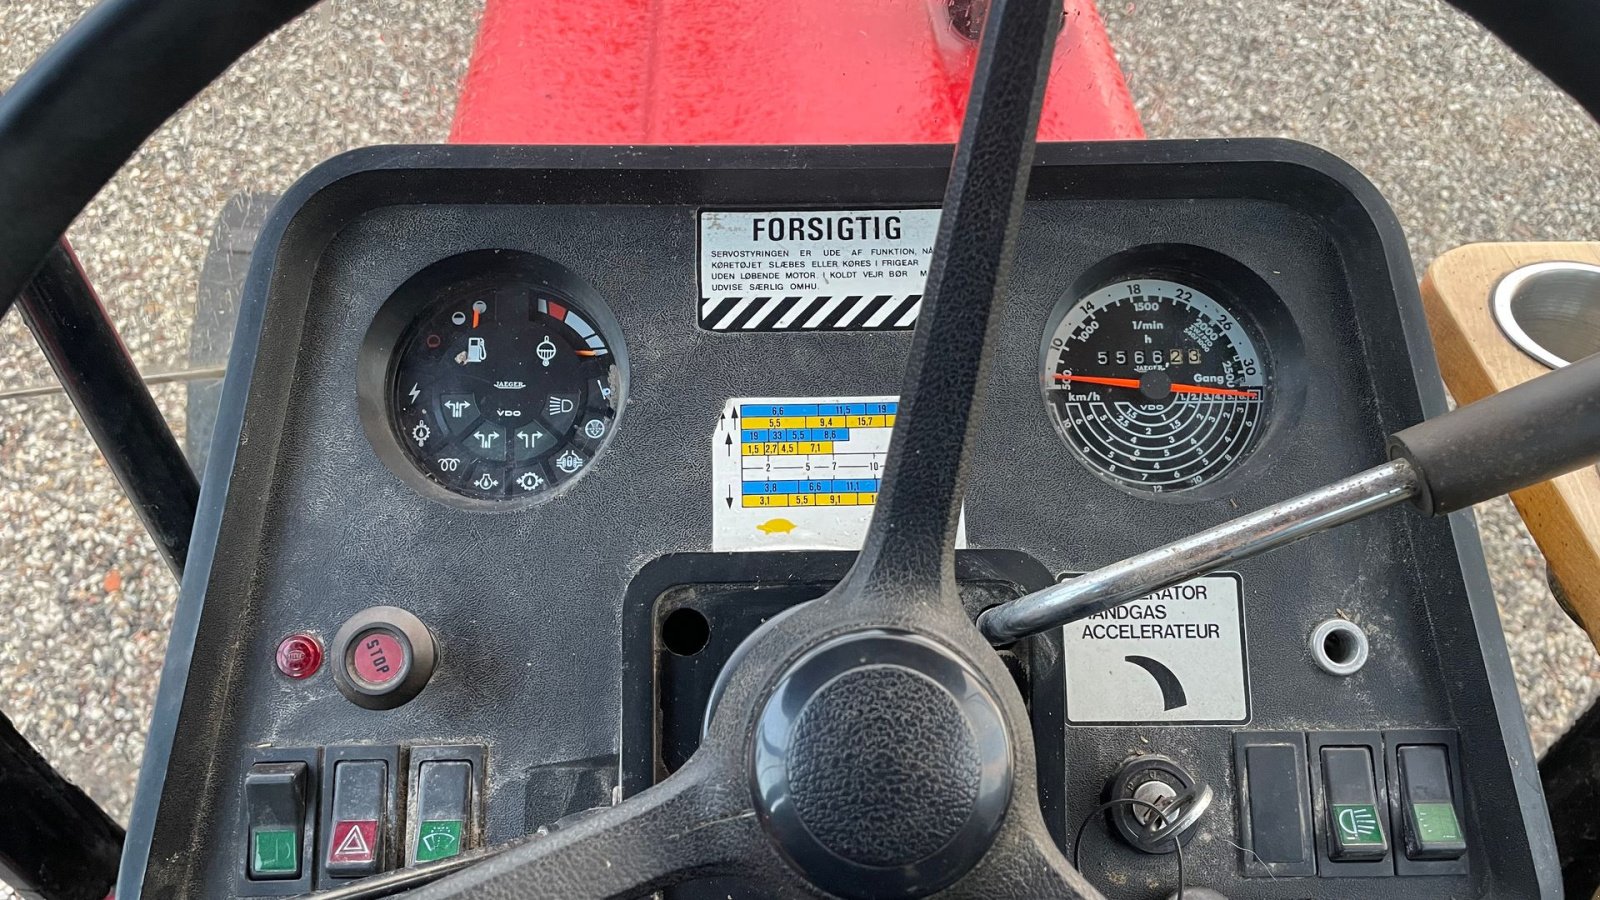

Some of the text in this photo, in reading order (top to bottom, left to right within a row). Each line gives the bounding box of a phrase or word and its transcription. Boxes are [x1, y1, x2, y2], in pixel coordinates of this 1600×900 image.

[753, 216, 901, 241] FORSIGTIG
[711, 250, 789, 258] SERVOSTYRINGEN
[823, 249, 841, 257] UDE
[922, 246, 933, 255] NÅ
[711, 261, 762, 269] KØRETØJET
[768, 260, 806, 268] SLÆBES
[811, 260, 838, 268] ELLER
[842, 259, 872, 268] KØRES
[882, 259, 919, 267] FRIGEAR
[711, 272, 735, 280] UDEN
[740, 272, 780, 280] LØBENDE
[830, 271, 858, 279] KOLDT
[889, 270, 908, 278] BØR
[711, 284, 743, 292] UDVISE
[749, 283, 784, 291] SÆRLIG
[1127, 284, 1142, 295] 18
[1174, 288, 1193, 303] 22
[1080, 301, 1096, 315] 14
[1133, 303, 1160, 312] 1500
[1132, 321, 1164, 330] 1/min
[1217, 314, 1233, 331] 26
[1077, 321, 1099, 342] 1000
[1196, 318, 1219, 341] 2000
[1144, 334, 1152, 344] h
[1050, 338, 1063, 352] 10
[1243, 358, 1257, 376] 30
[1193, 373, 1224, 385] Gang
[494, 381, 526, 389] JAEGER
[1068, 392, 1101, 401] km/h
[771, 404, 887, 417] 6,6 11,5 19
[769, 416, 873, 429] 5,5 9,4 15,7
[1063, 418, 1071, 428] 10
[750, 431, 760, 441] 19
[772, 431, 783, 440] 33
[792, 431, 805, 442] 5,5
[1146, 427, 1152, 435] 2
[1108, 450, 1115, 458] 5
[1134, 449, 1140, 457] 6
[1164, 449, 1170, 457] 5
[1202, 457, 1209, 465] 5
[765, 461, 879, 473] 2 5 7 10
[1110, 464, 1116, 472] 8
[1193, 475, 1202, 484] 10
[764, 481, 860, 493] 3,8 6,6 11,1
[1153, 485, 1163, 493] 12
[795, 495, 809, 505] 5,5
[1088, 605, 1167, 620] ANDGAS
[1082, 624, 1220, 639] ACCELERATEUR
[366, 639, 390, 673] STOP
